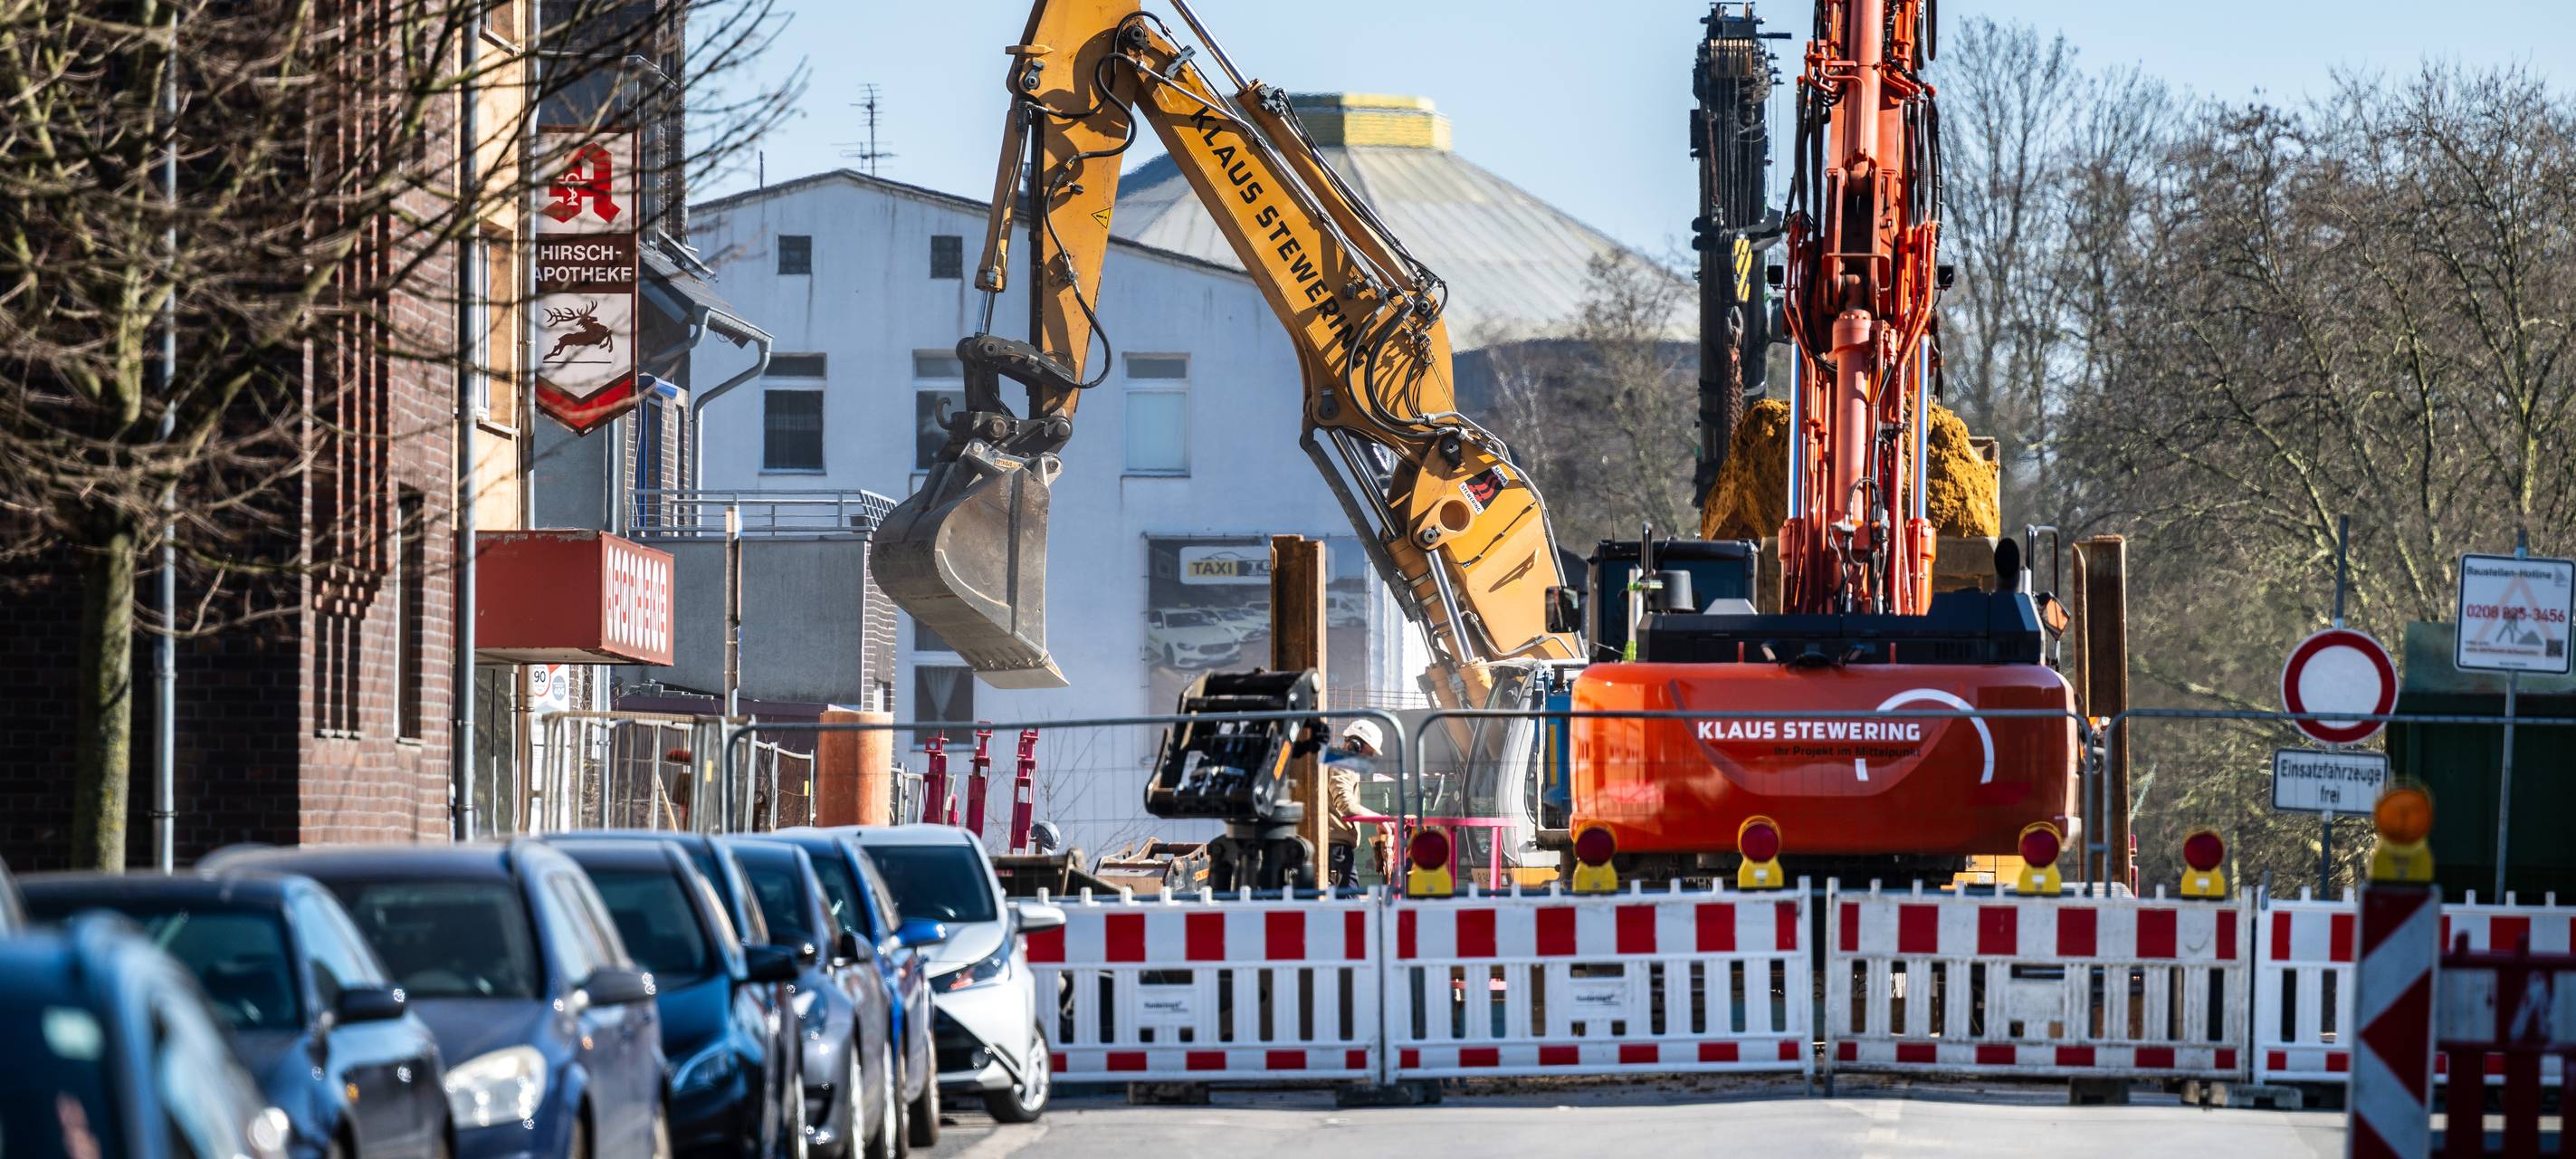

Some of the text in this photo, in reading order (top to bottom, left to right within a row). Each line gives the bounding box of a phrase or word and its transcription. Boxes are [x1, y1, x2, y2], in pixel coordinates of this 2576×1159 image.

[1189, 106, 1370, 369] KLAUS STEWERING
[540, 244, 622, 261] HIRSCH-
[1494, 466, 1508, 484] KLAUS
[1460, 484, 1482, 512] STEWERING
[1193, 562, 1233, 576] TAXI
[605, 560, 668, 637] APOTHEKE
[2466, 604, 2499, 619] 0208
[534, 670, 547, 683] 90
[1698, 722, 1921, 741] KLAUS STEWERING
[1774, 746, 1921, 758] Ihr Projekt im Mittelpunkt
[2281, 760, 2382, 786] Einsatzfahrzeuge
[2320, 785, 2341, 804] frei
